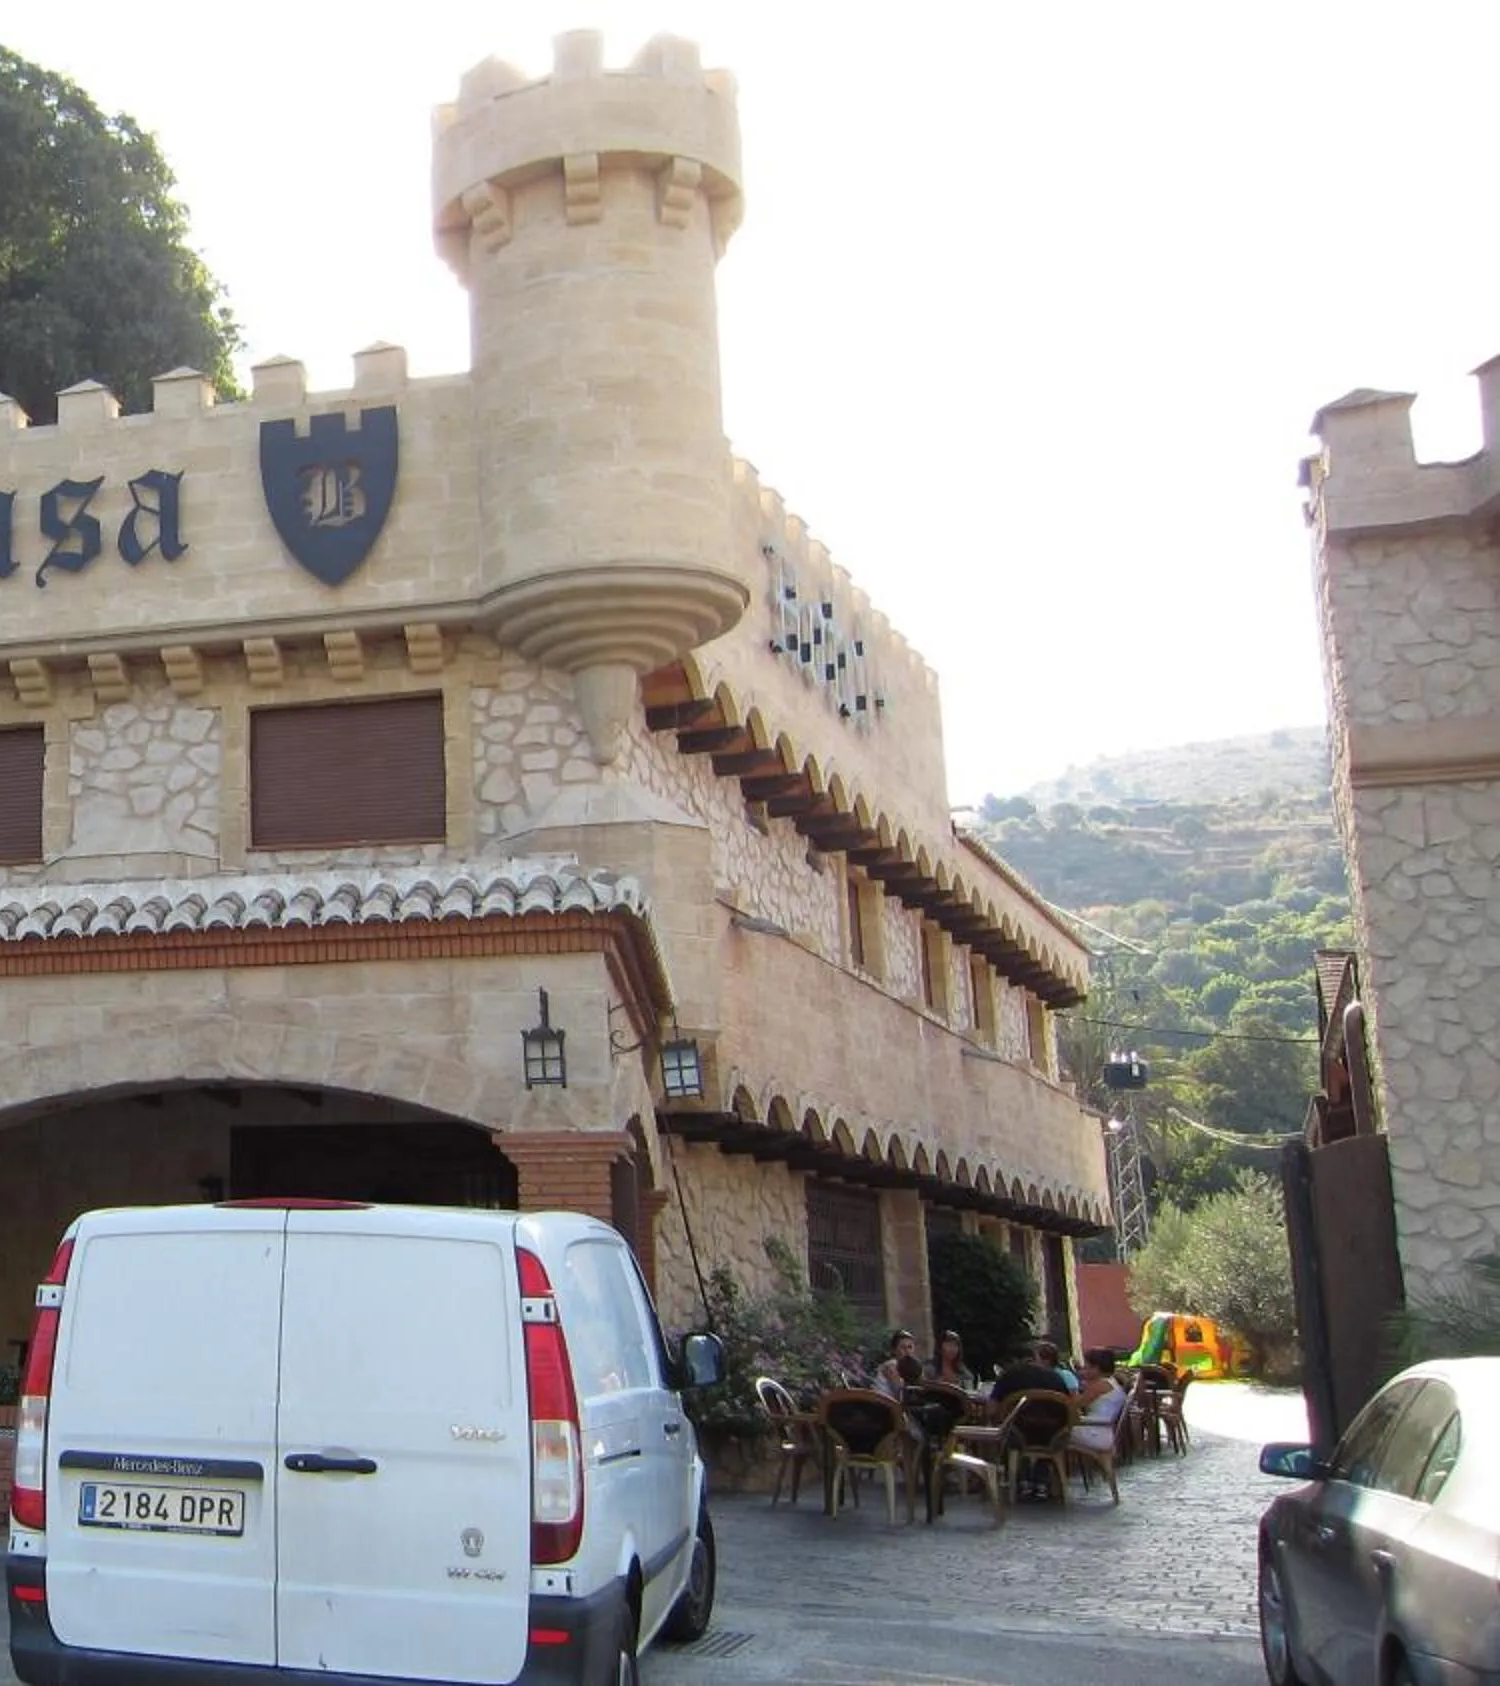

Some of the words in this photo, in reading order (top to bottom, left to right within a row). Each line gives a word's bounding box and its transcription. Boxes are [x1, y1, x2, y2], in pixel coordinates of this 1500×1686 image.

[113, 1457, 204, 1475] Mercedes-Benz
[100, 1490, 169, 1521] 2184
[179, 1495, 234, 1527] DPR
